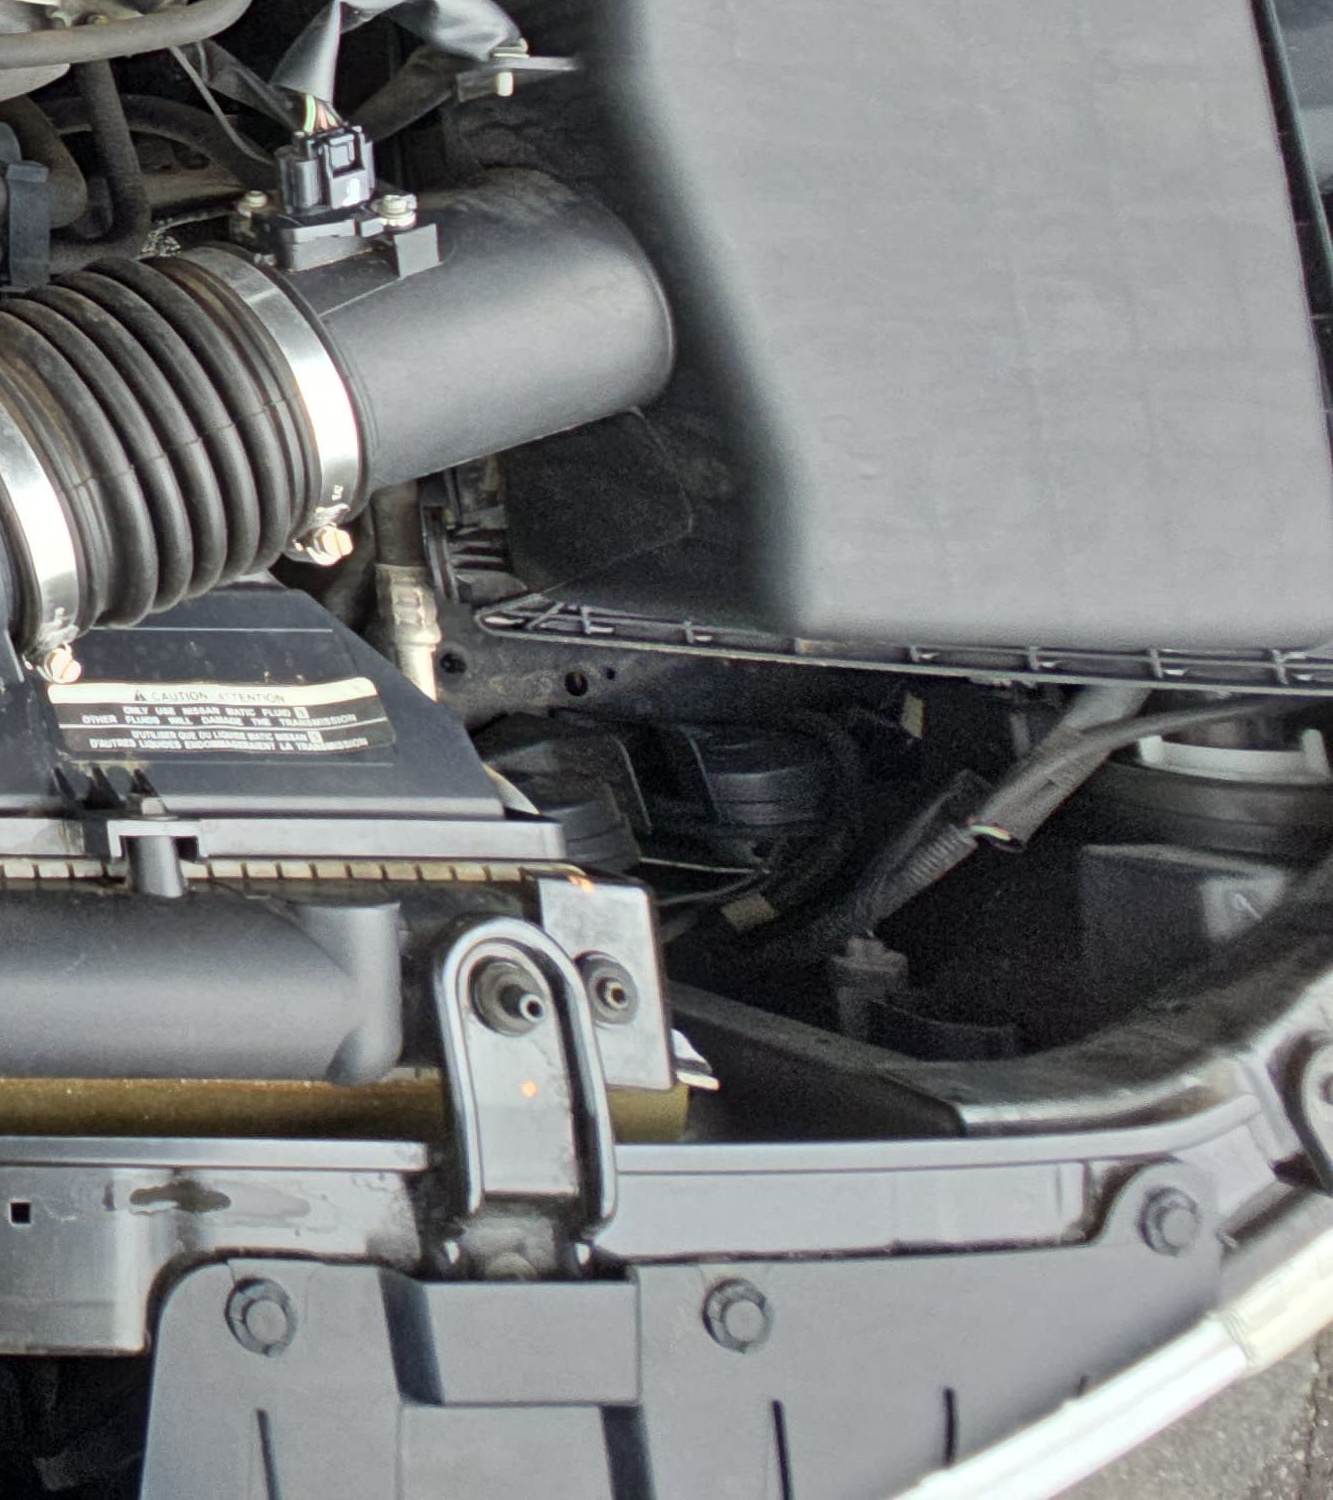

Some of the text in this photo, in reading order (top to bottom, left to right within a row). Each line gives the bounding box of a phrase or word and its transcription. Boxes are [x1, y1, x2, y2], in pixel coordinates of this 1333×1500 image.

[152, 691, 208, 701] CAUTION
[123, 706, 149, 716] ONLY
[155, 707, 176, 716] USE
[182, 707, 220, 716] NISSAN
[262, 708, 291, 718] FLUID
[82, 714, 357, 726] OTHER FLUIDS WILL DAMAGE THE TRANSMISSION
[139, 738, 182, 749] LIQUIDES
[282, 740, 295, 750] LA
[298, 737, 368, 750] TRANSMISSION
